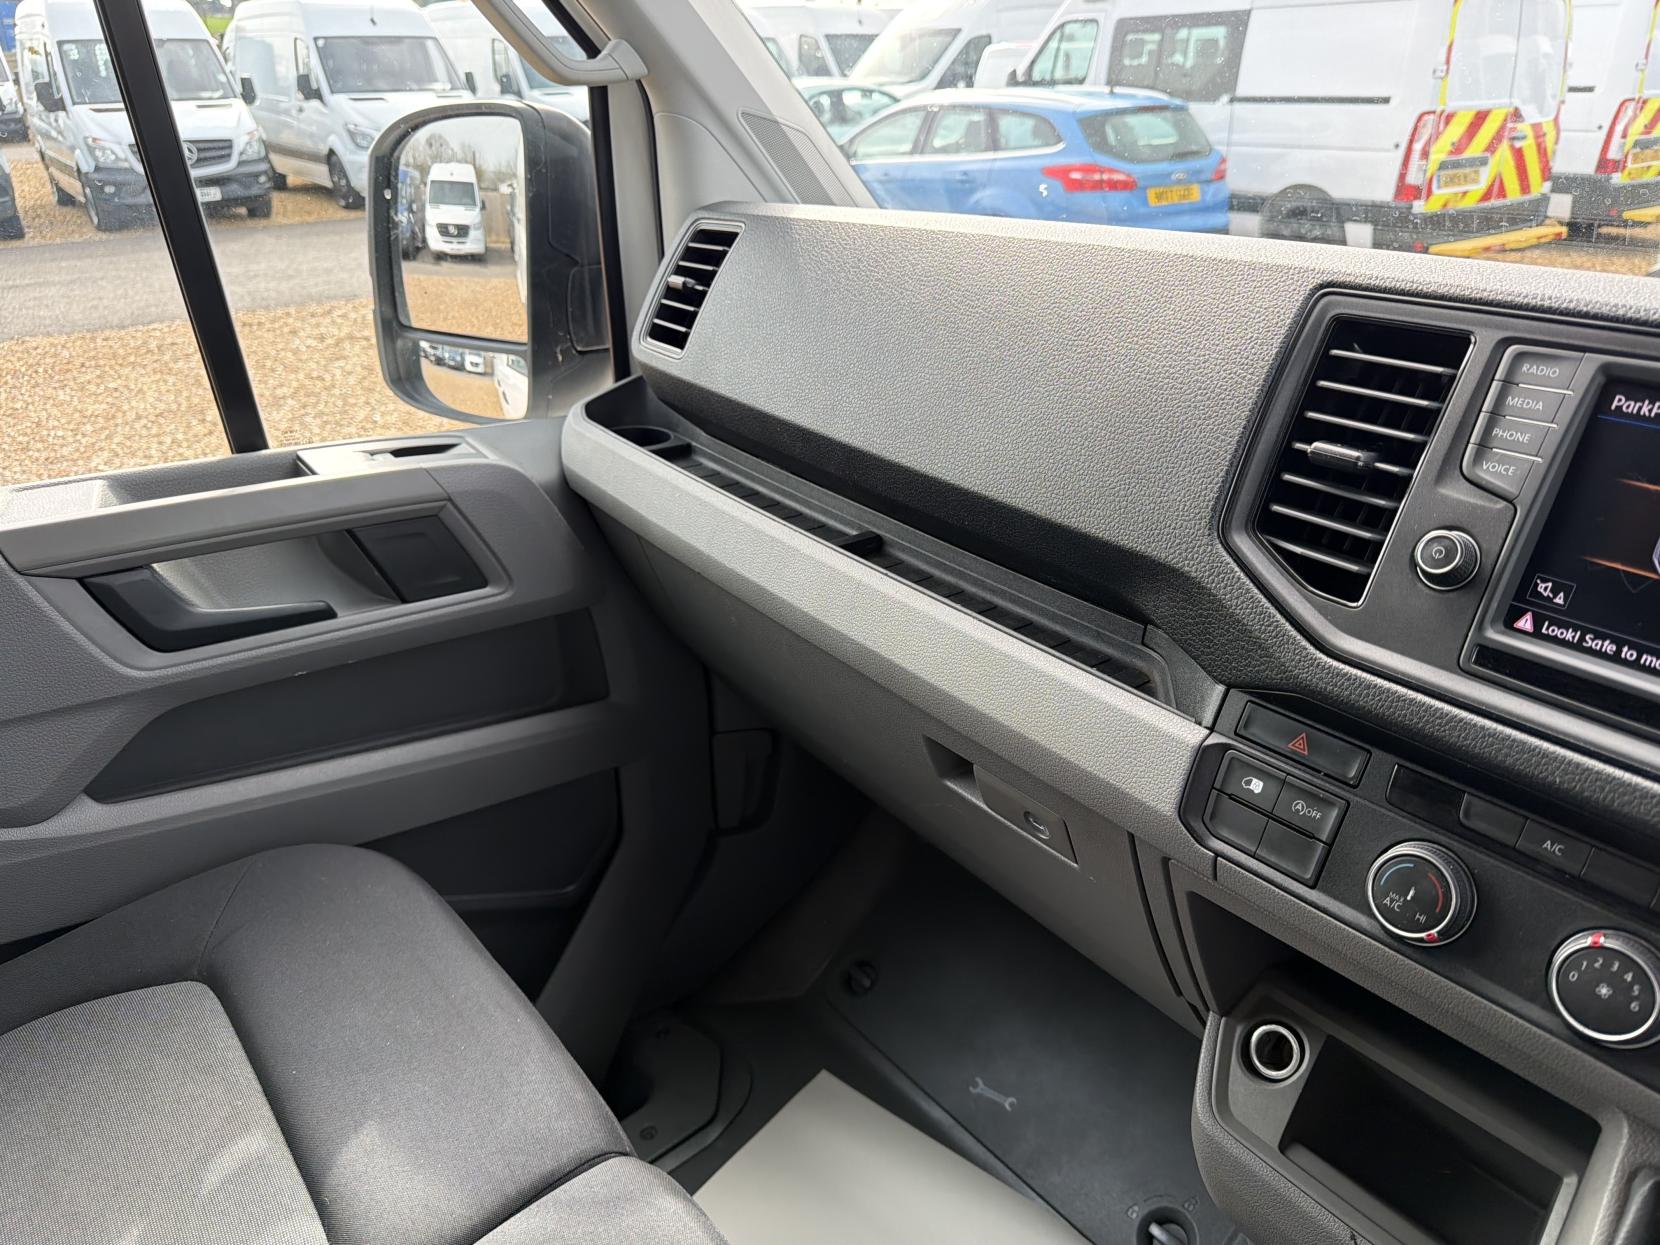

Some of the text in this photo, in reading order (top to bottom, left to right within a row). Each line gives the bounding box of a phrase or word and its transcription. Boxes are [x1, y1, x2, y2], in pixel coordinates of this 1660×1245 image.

[1521, 363, 1560, 377] RADIO
[1506, 396, 1543, 410] MEDIA
[1492, 427, 1531, 443] PHONE
[1482, 460, 1517, 476] VOICE
[1582, 633, 1617, 655] Safe
[1620, 645, 1637, 661] to
[1305, 808, 1322, 820] OFF
[1542, 840, 1565, 856] A/C
[1383, 896, 1403, 912] A/C
[1414, 912, 1427, 924] HI
[1581, 961, 1588, 971] 1
[1593, 957, 1603, 969] 2
[1610, 960, 1620, 972] 3
[1568, 970, 1579, 982] 0
[1623, 972, 1634, 983] 4
[1632, 984, 1641, 996] 5
[1630, 1001, 1640, 1012] 6
